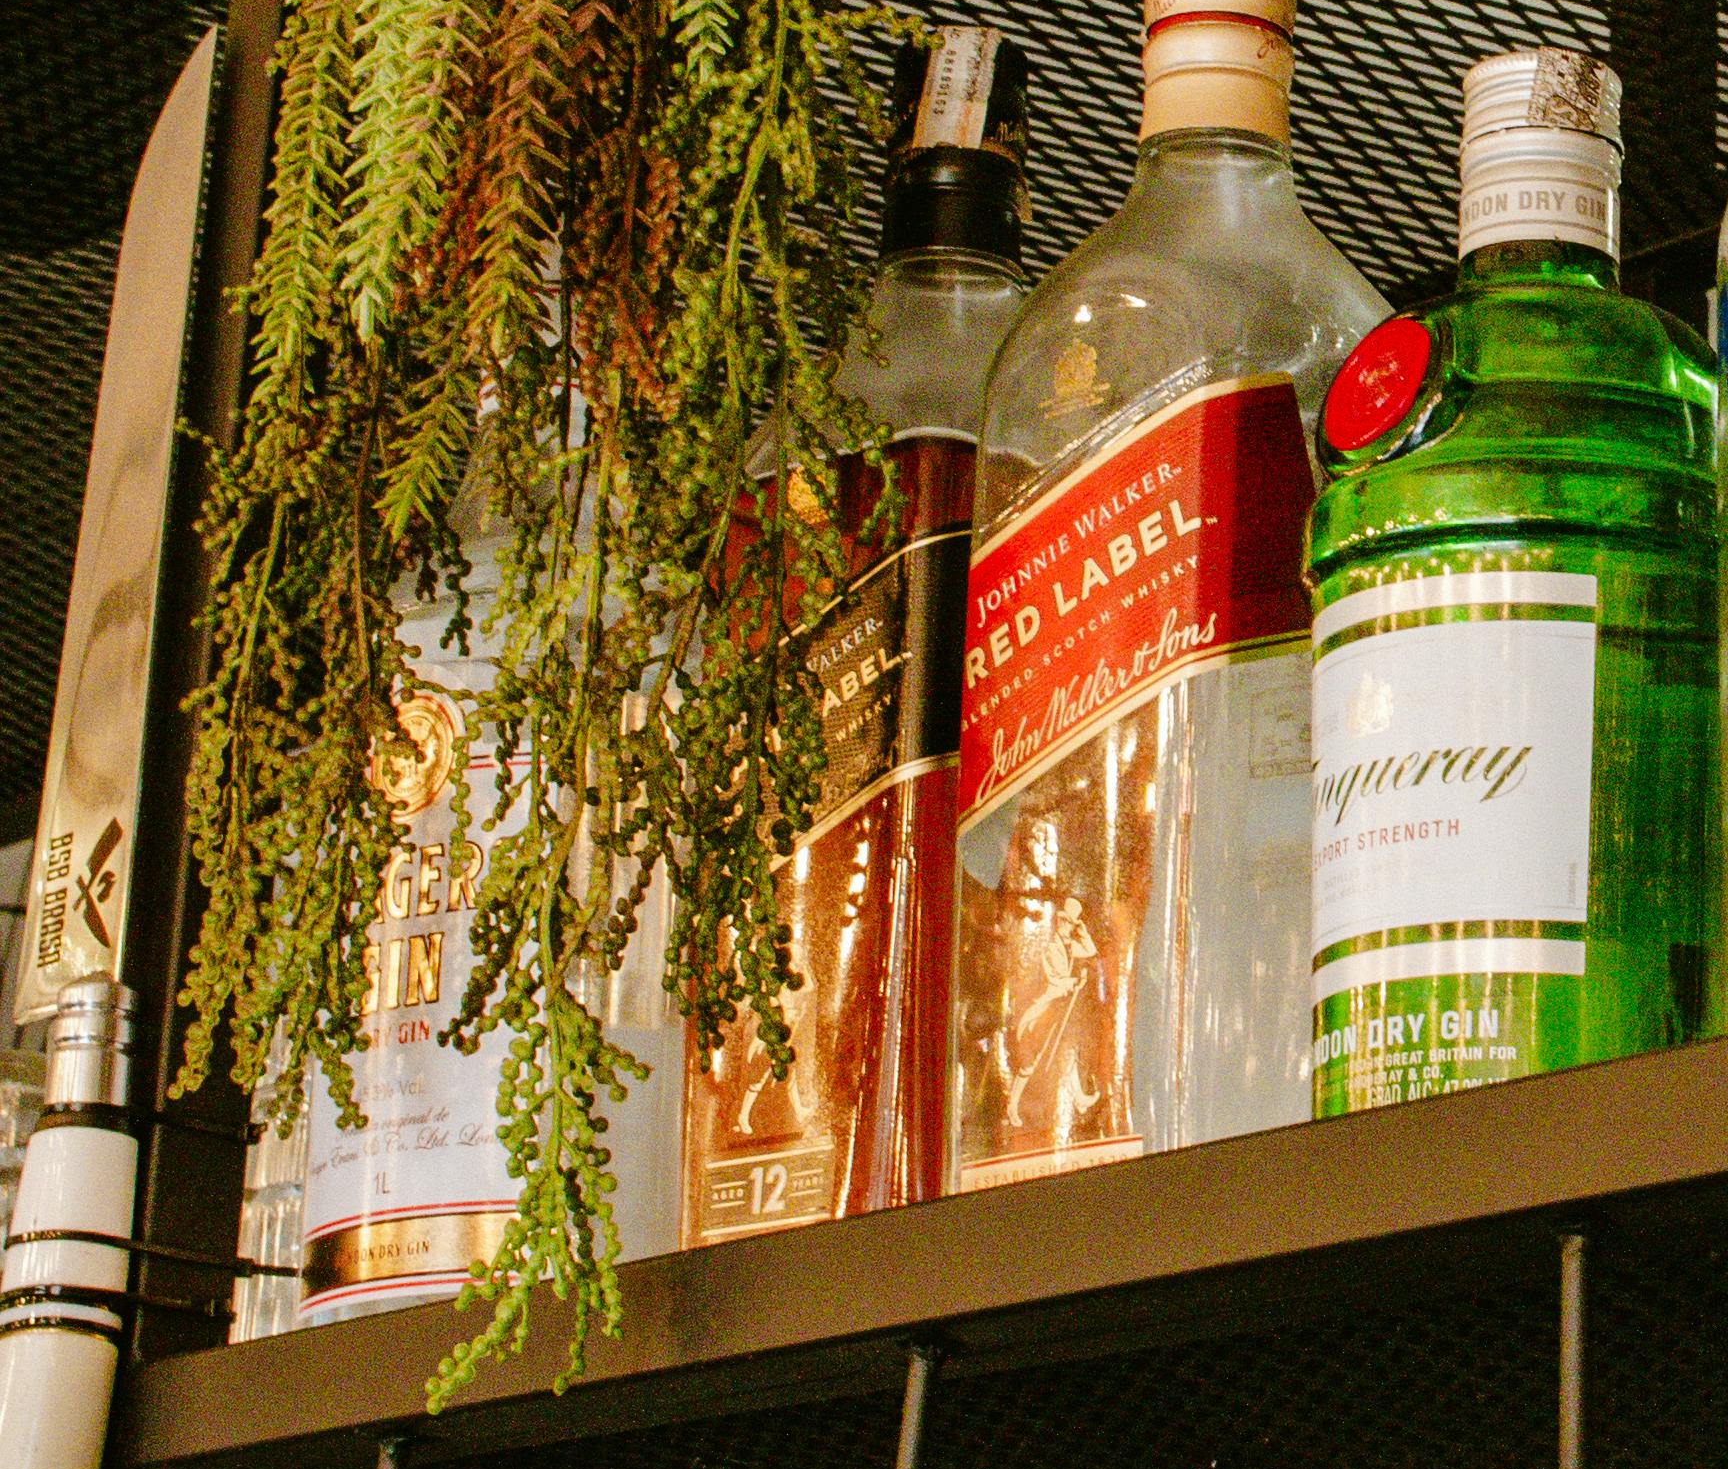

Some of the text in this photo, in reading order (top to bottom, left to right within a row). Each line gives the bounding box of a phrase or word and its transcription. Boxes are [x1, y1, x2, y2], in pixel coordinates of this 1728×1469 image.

[1462, 192, 1509, 225] NDON
[1518, 190, 1566, 212] DRY
[976, 462, 1176, 628] JOHNNIE WALKER
[965, 498, 1203, 690] RED LABEL
[1042, 608, 1112, 667] SCOTCH
[1119, 553, 1200, 610] WHISKY
[821, 647, 895, 718] ABEL
[835, 693, 892, 743] WHISKY
[973, 715, 1042, 808] John
[1042, 657, 1138, 740] Walker
[1357, 818, 1461, 852] STRENGTH
[37, 832, 75, 969] BSB BRASA
[398, 1019, 431, 1046] GIN
[1313, 1024, 1358, 1069] NDON
[1368, 1012, 1425, 1049] DRY
[1440, 1009, 1500, 1041] GIN
[1385, 1049, 1425, 1069] GREAT
[1428, 1045, 1483, 1064] BRITAIN
[1489, 1045, 1518, 1061] FOR
[750, 1163, 788, 1216] 12
[407, 1239, 430, 1257] GIN
